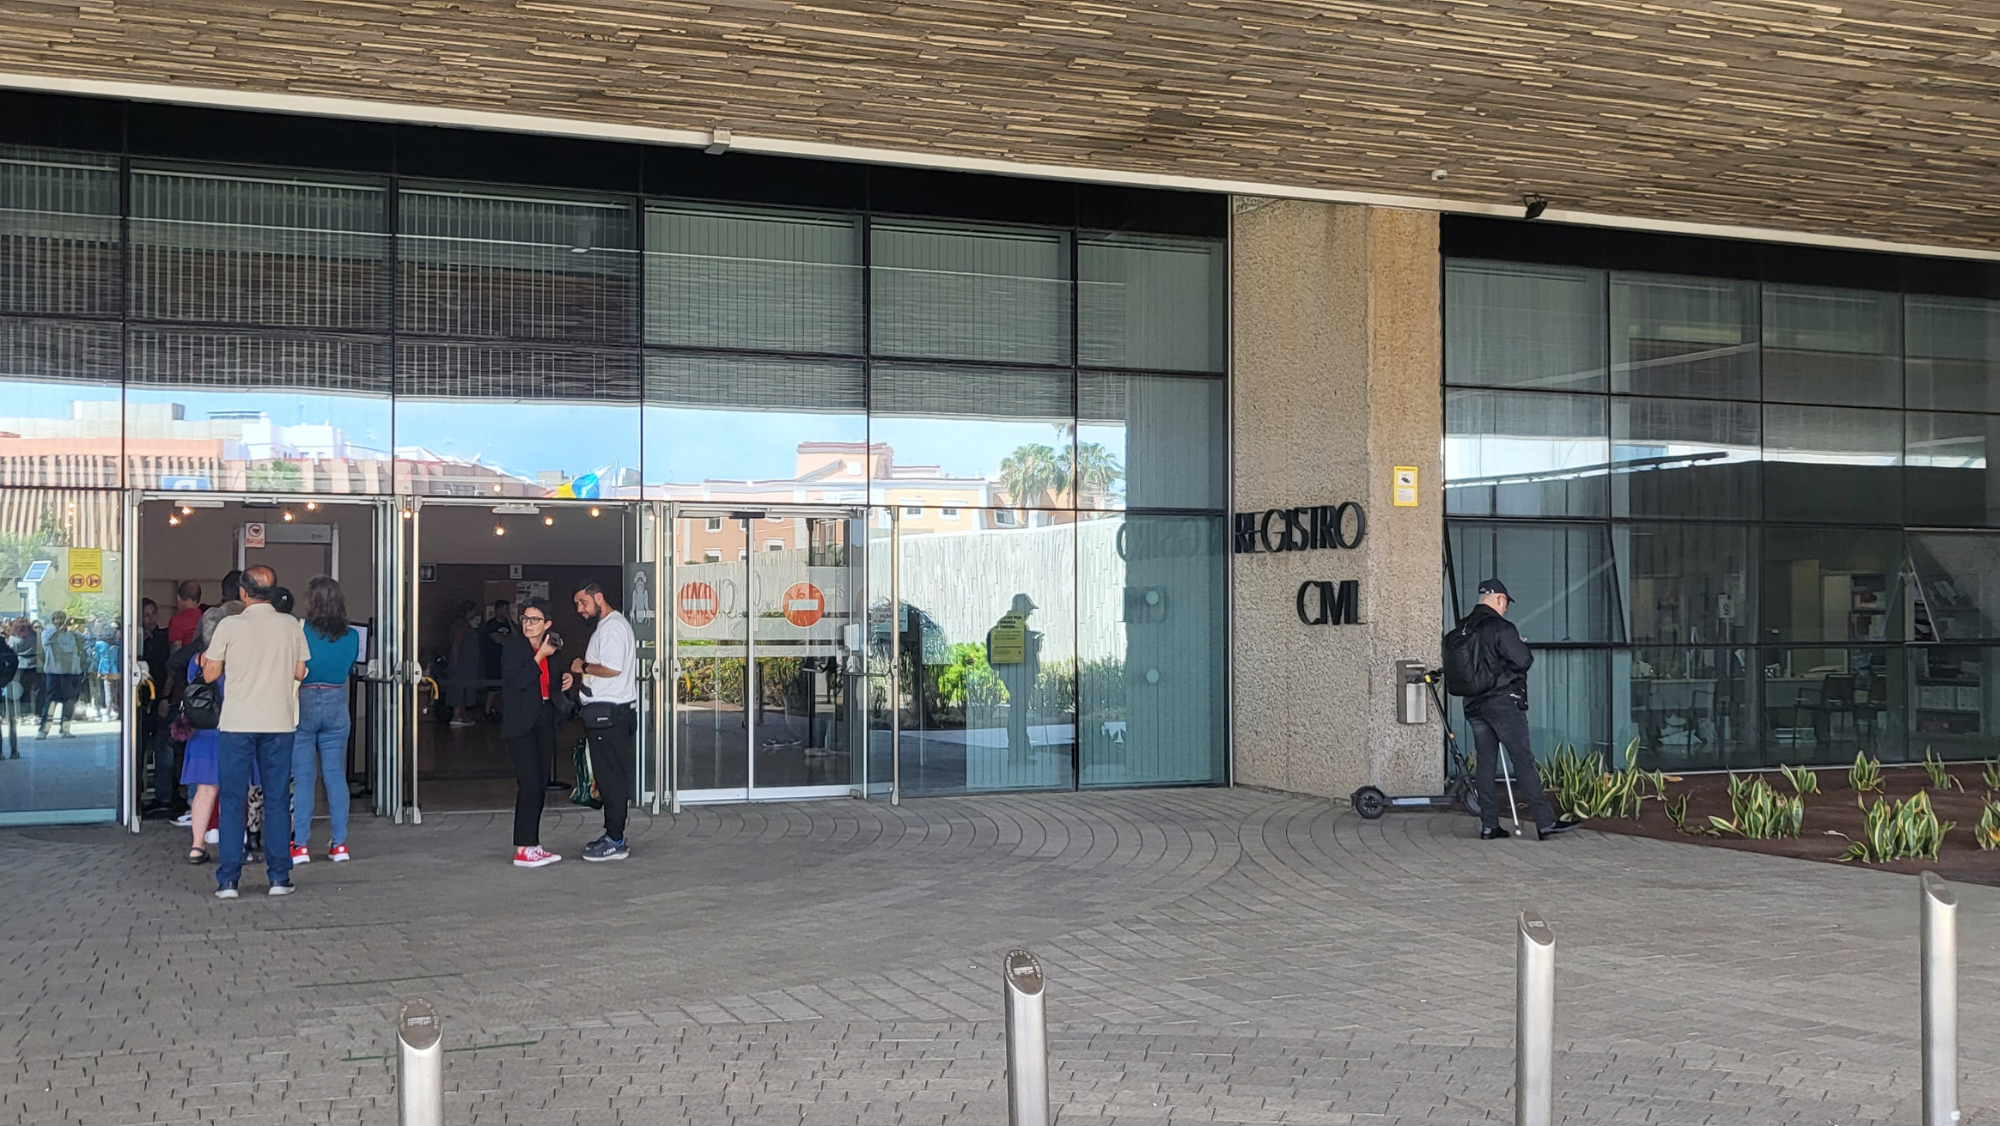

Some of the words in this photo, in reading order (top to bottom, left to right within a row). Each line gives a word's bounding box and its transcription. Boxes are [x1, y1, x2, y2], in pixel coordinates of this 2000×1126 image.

[1235, 501, 1366, 554] REGISTRO
[1297, 580, 1368, 625] CIVIL
[1723, 603, 1729, 616] 9
